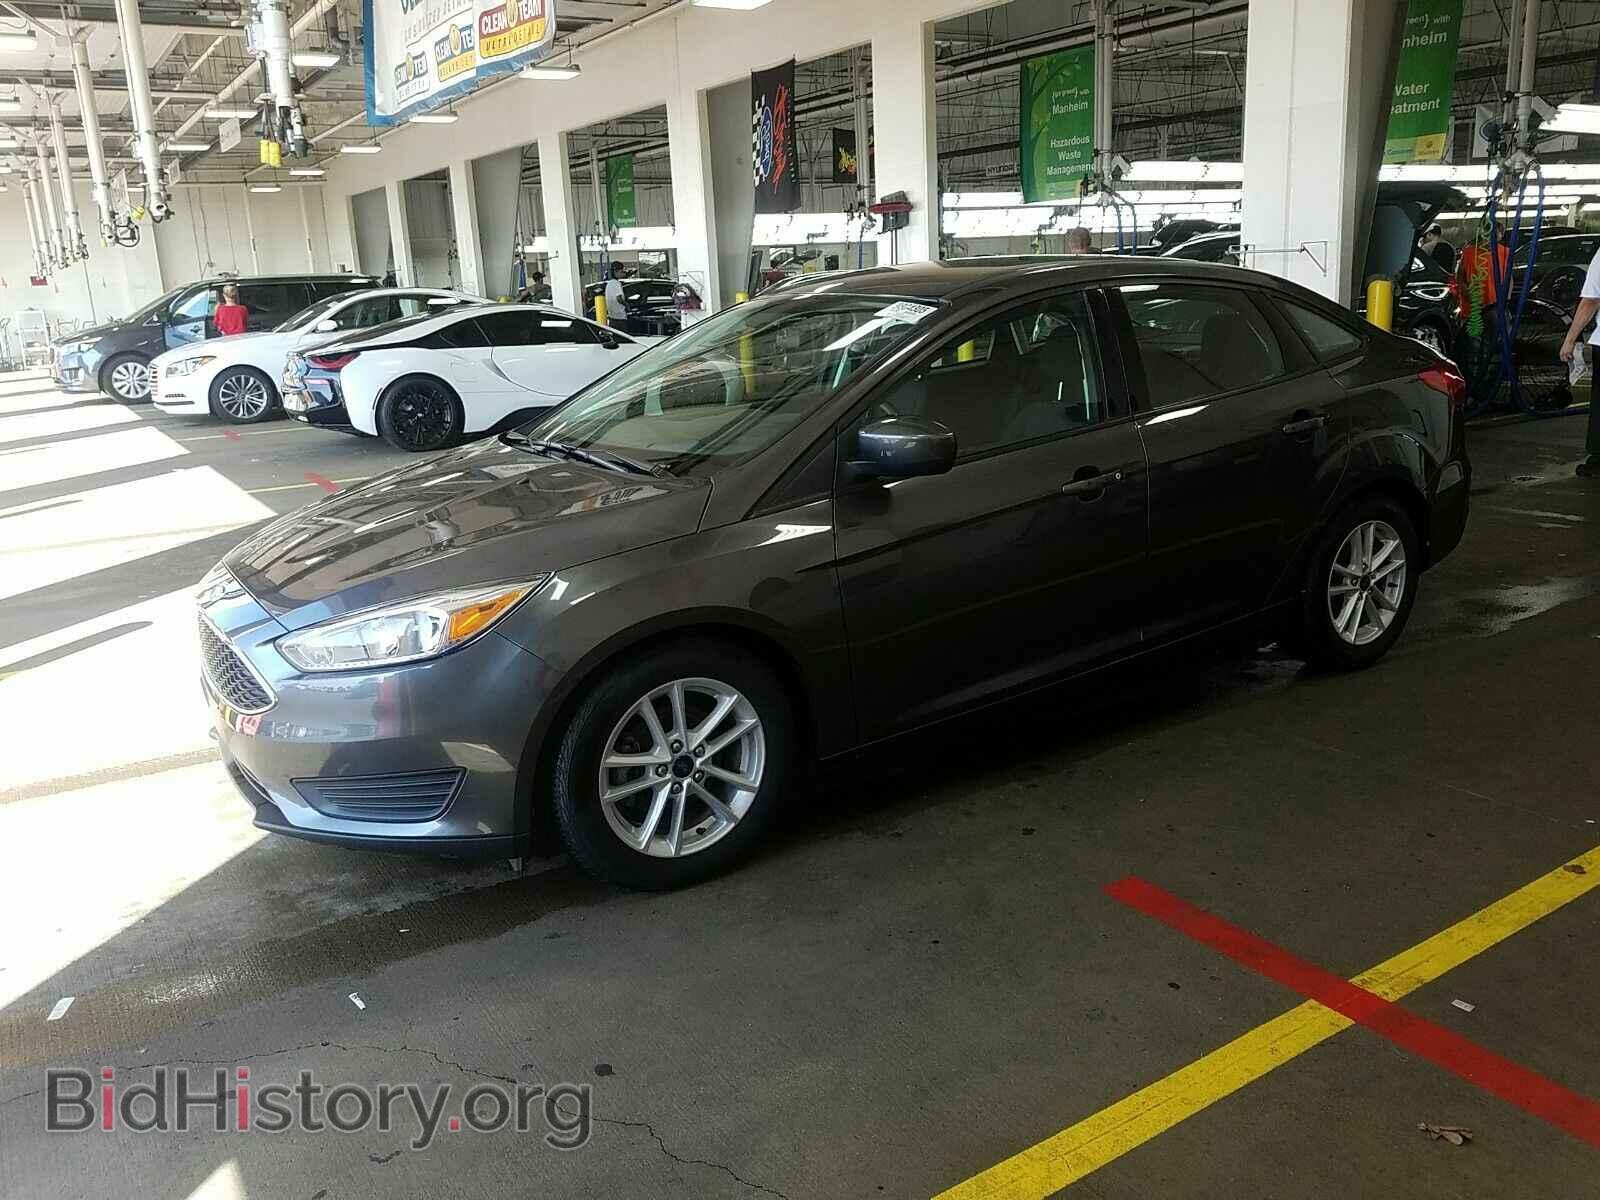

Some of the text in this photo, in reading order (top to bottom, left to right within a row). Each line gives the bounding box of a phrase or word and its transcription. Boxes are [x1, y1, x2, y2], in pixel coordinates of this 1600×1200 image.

[481, 0, 542, 35] CLEAN TEAM
[1053, 101, 1089, 115] Manheim
[1050, 136, 1090, 148] Hazardous
[1058, 150, 1081, 161] Waste
